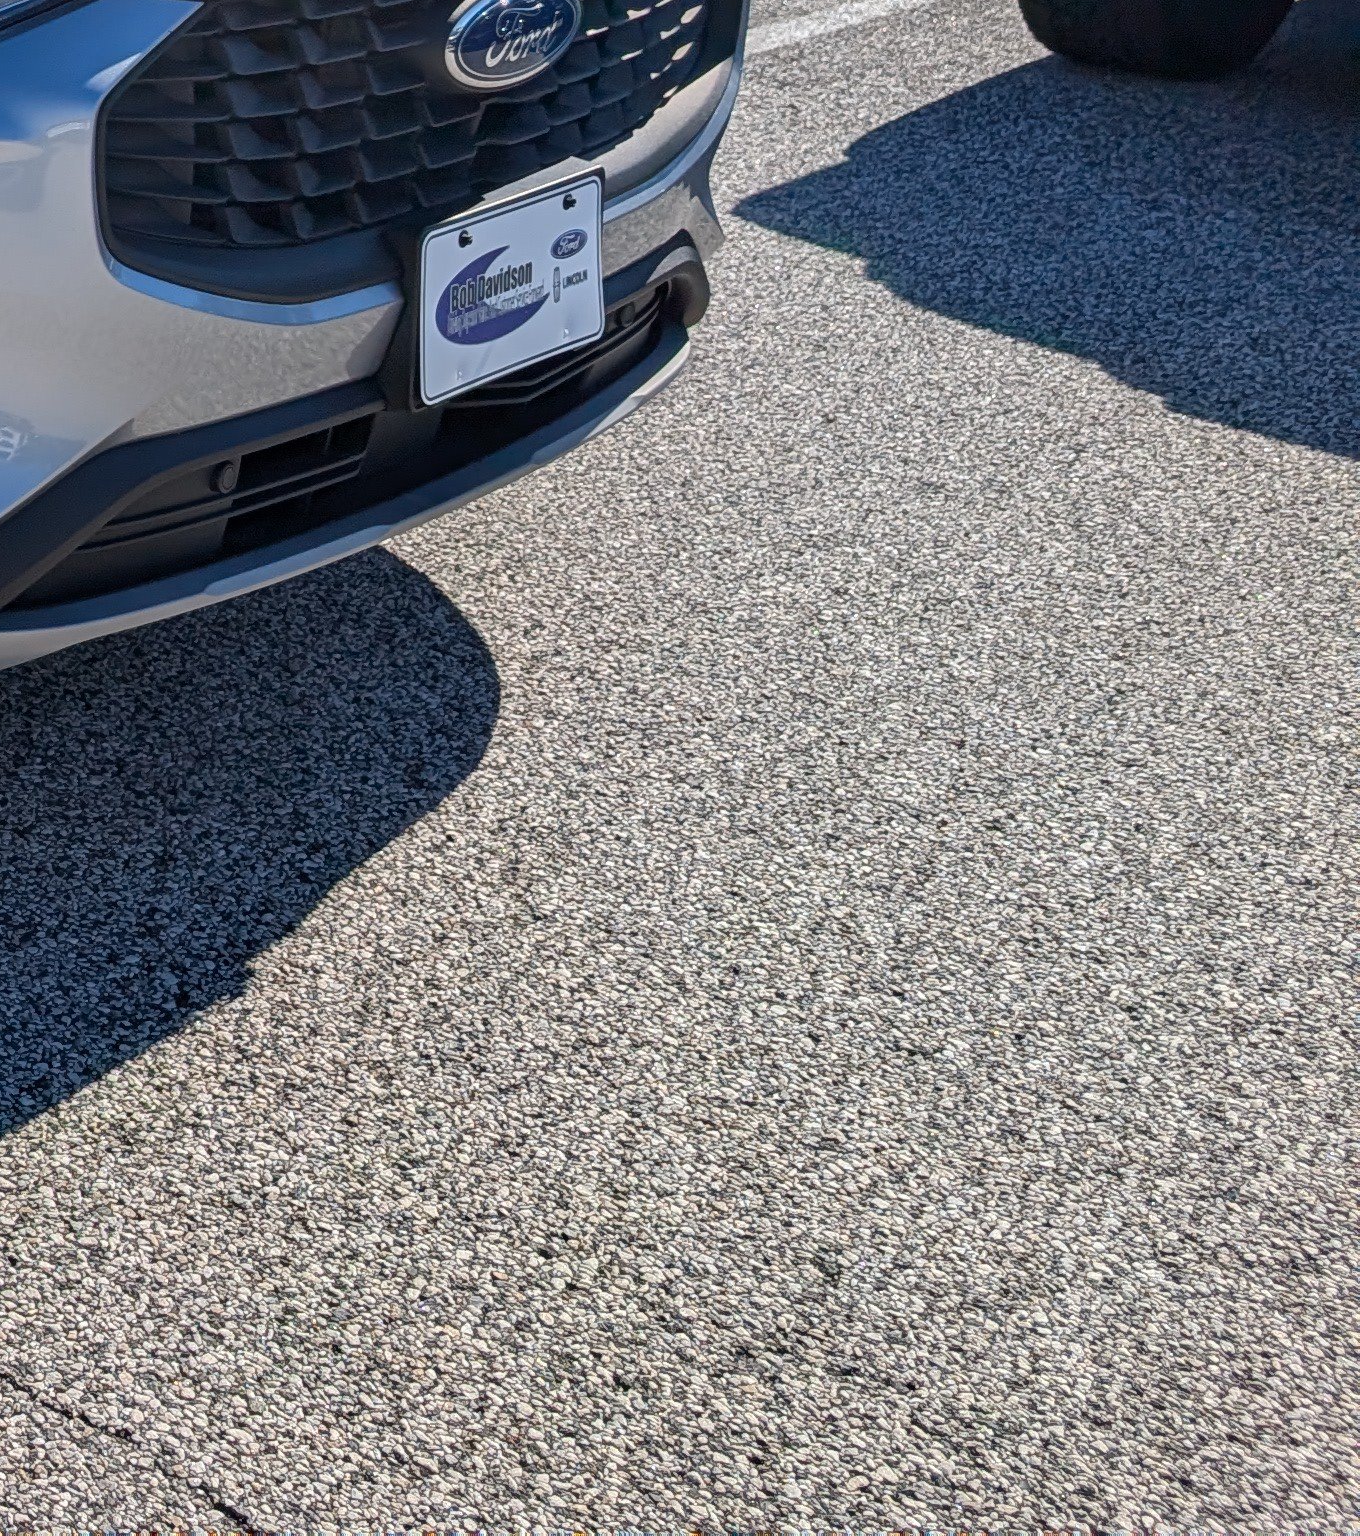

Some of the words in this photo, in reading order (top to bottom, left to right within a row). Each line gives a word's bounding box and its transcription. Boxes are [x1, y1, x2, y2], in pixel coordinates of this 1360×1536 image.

[485, 3, 564, 68] Ford
[557, 234, 581, 255] Ford
[450, 278, 477, 312] Bob
[478, 261, 533, 303] Davidson
